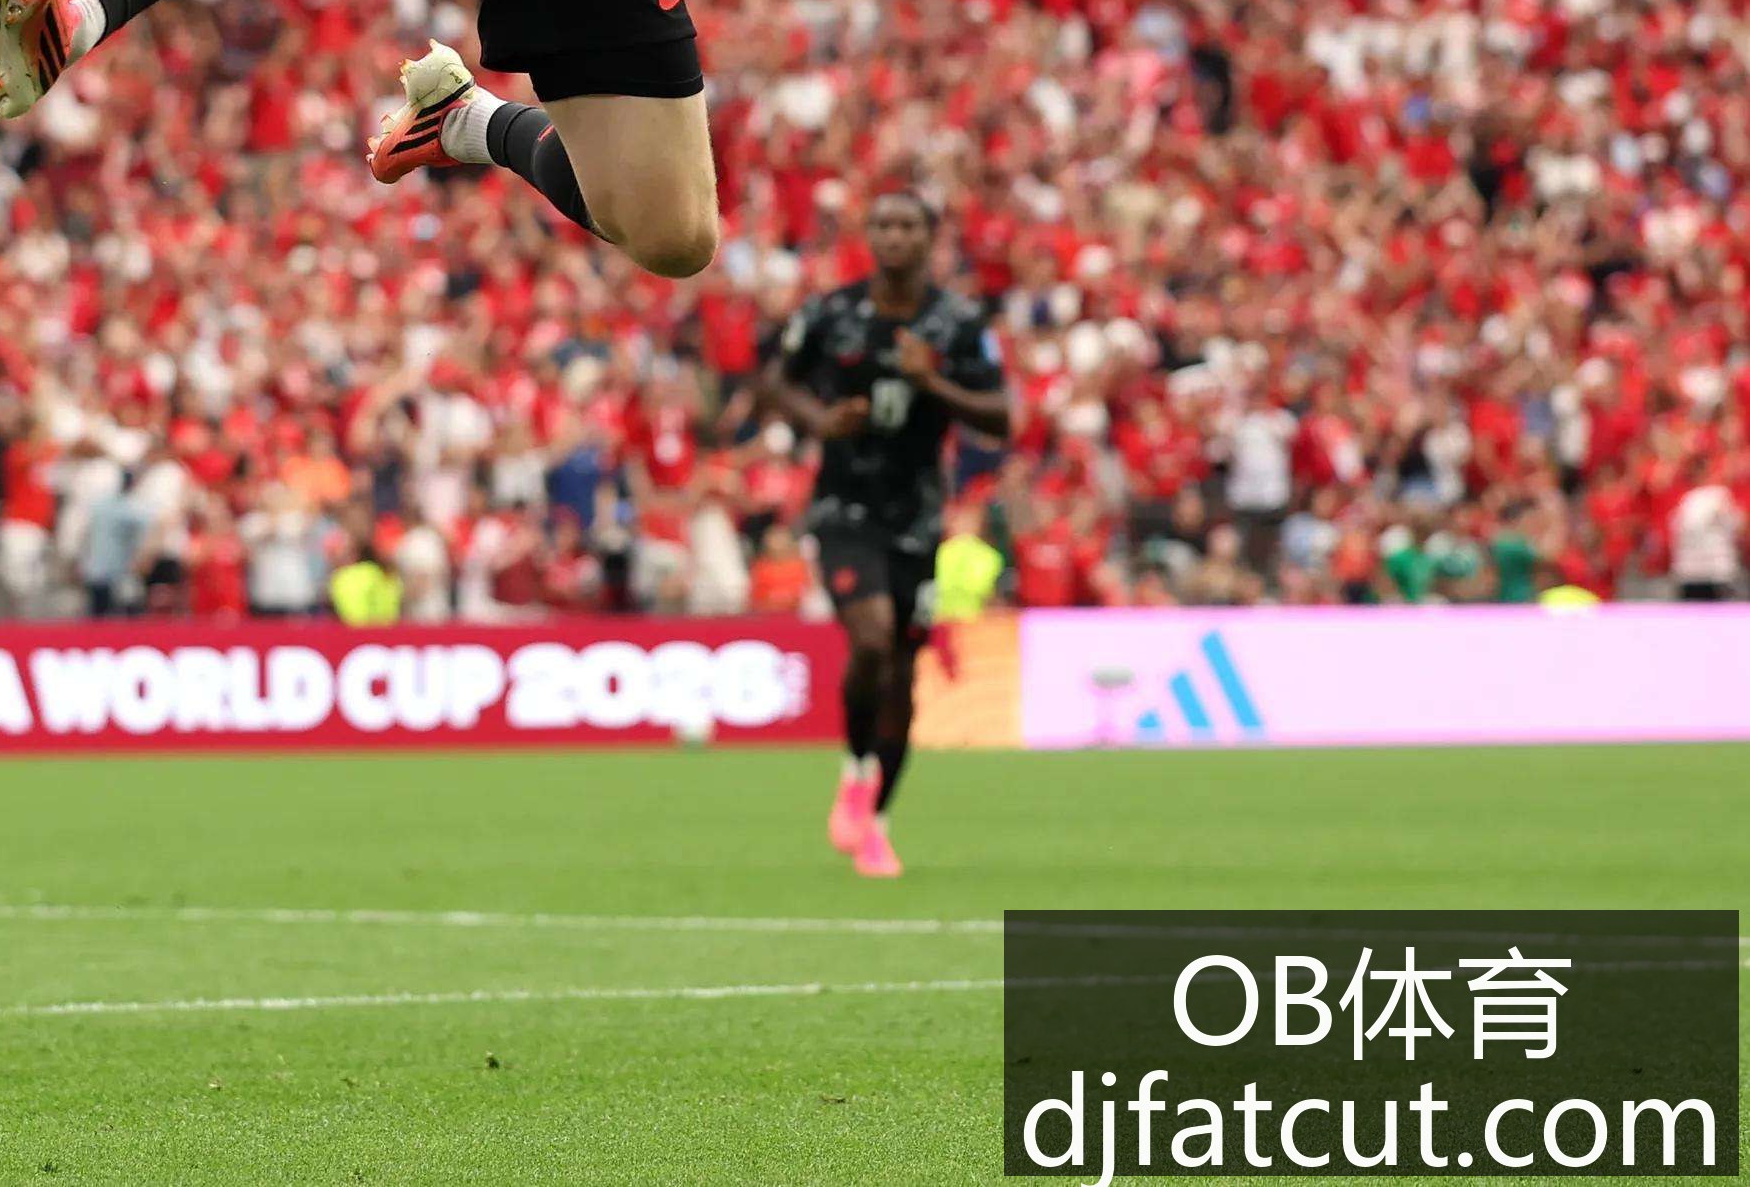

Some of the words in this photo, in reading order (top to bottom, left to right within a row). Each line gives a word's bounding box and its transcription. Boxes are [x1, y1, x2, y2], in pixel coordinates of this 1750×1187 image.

[29, 645, 336, 734] WORLD
[336, 644, 507, 732] CUP
[504, 640, 787, 730] 2026
